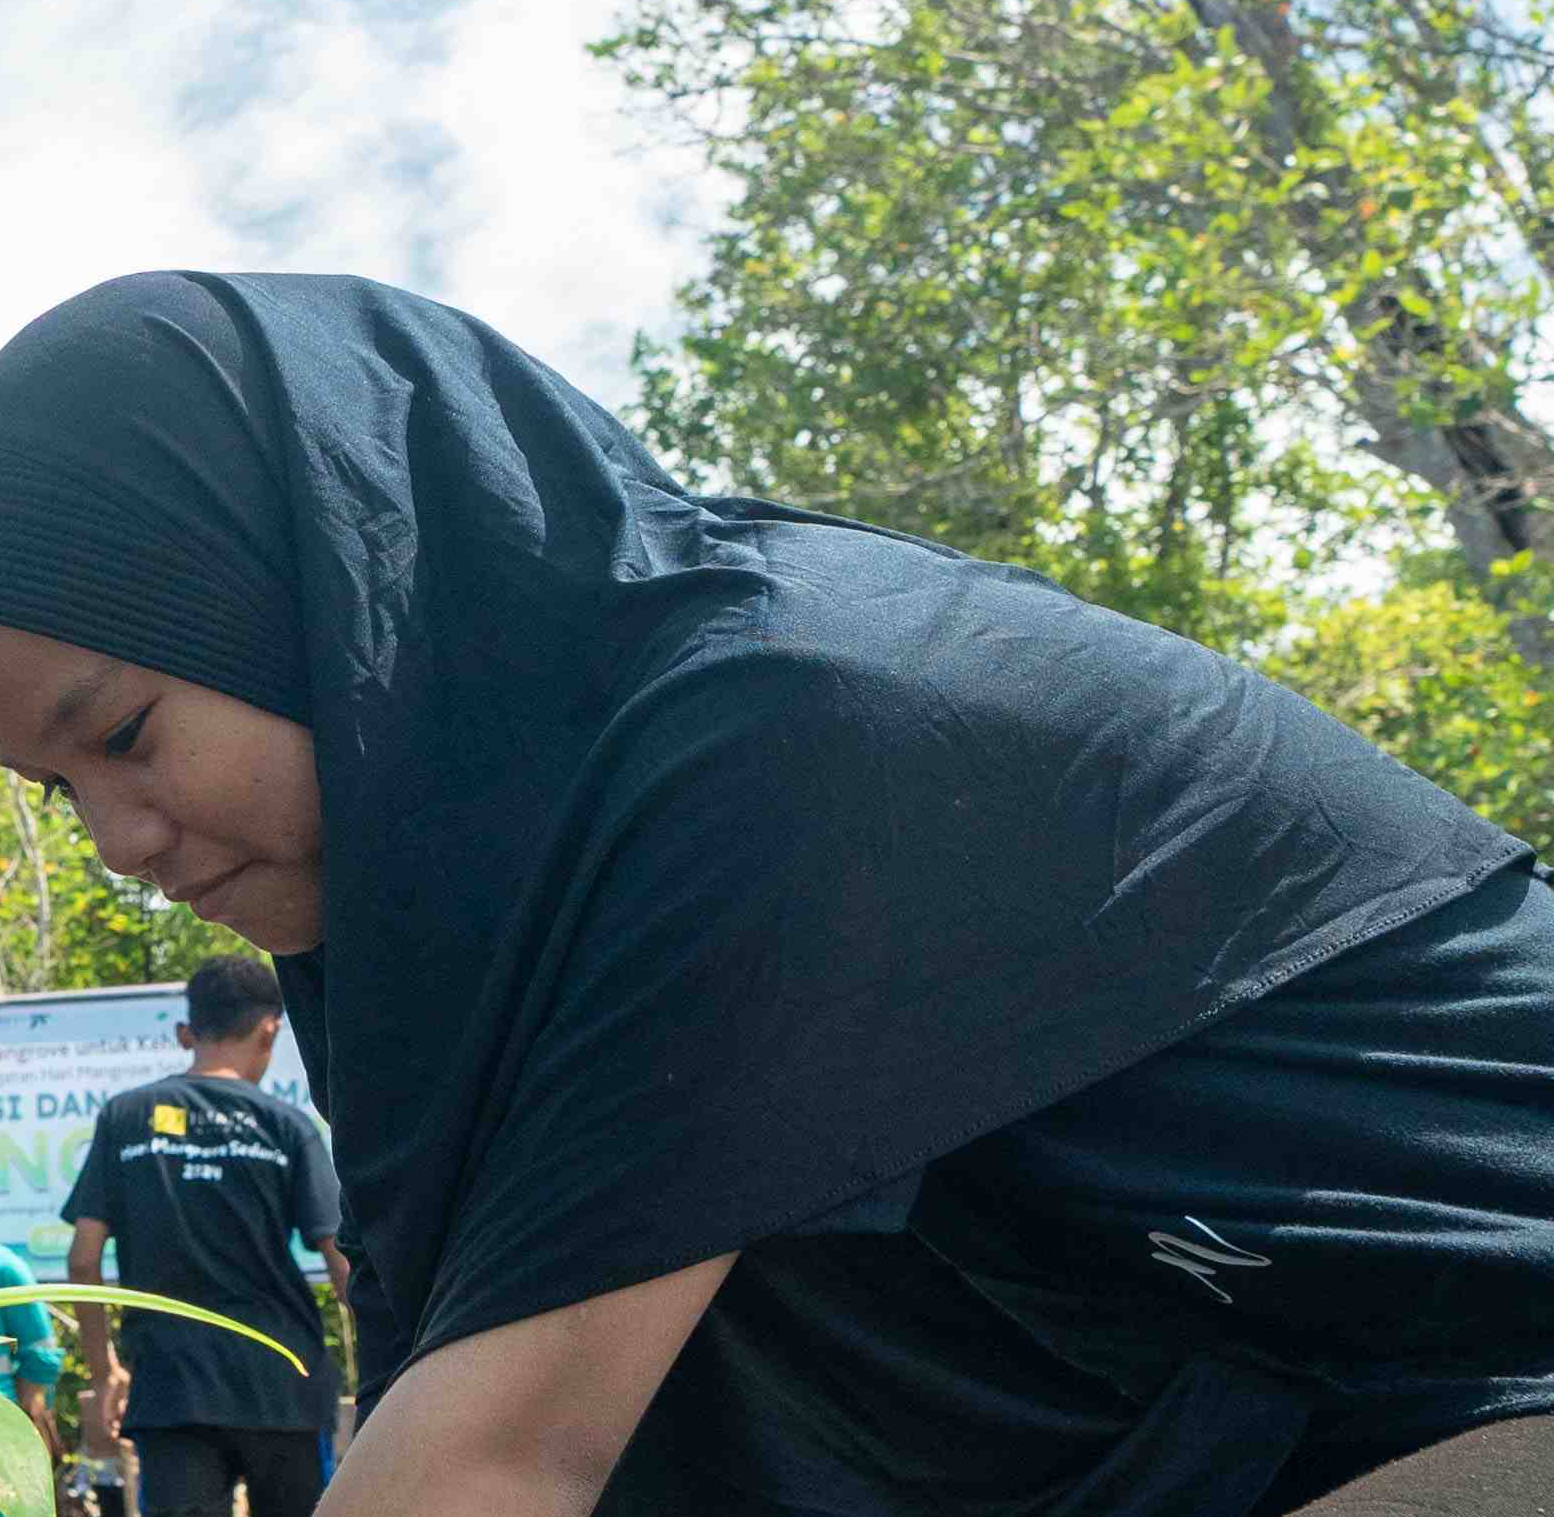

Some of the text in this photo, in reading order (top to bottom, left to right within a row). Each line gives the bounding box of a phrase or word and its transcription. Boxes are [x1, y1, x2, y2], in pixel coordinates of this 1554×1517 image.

[76, 1036, 129, 1056] untuk
[37, 1090, 108, 1119] DAN
[151, 1136, 229, 1159] Mangrove
